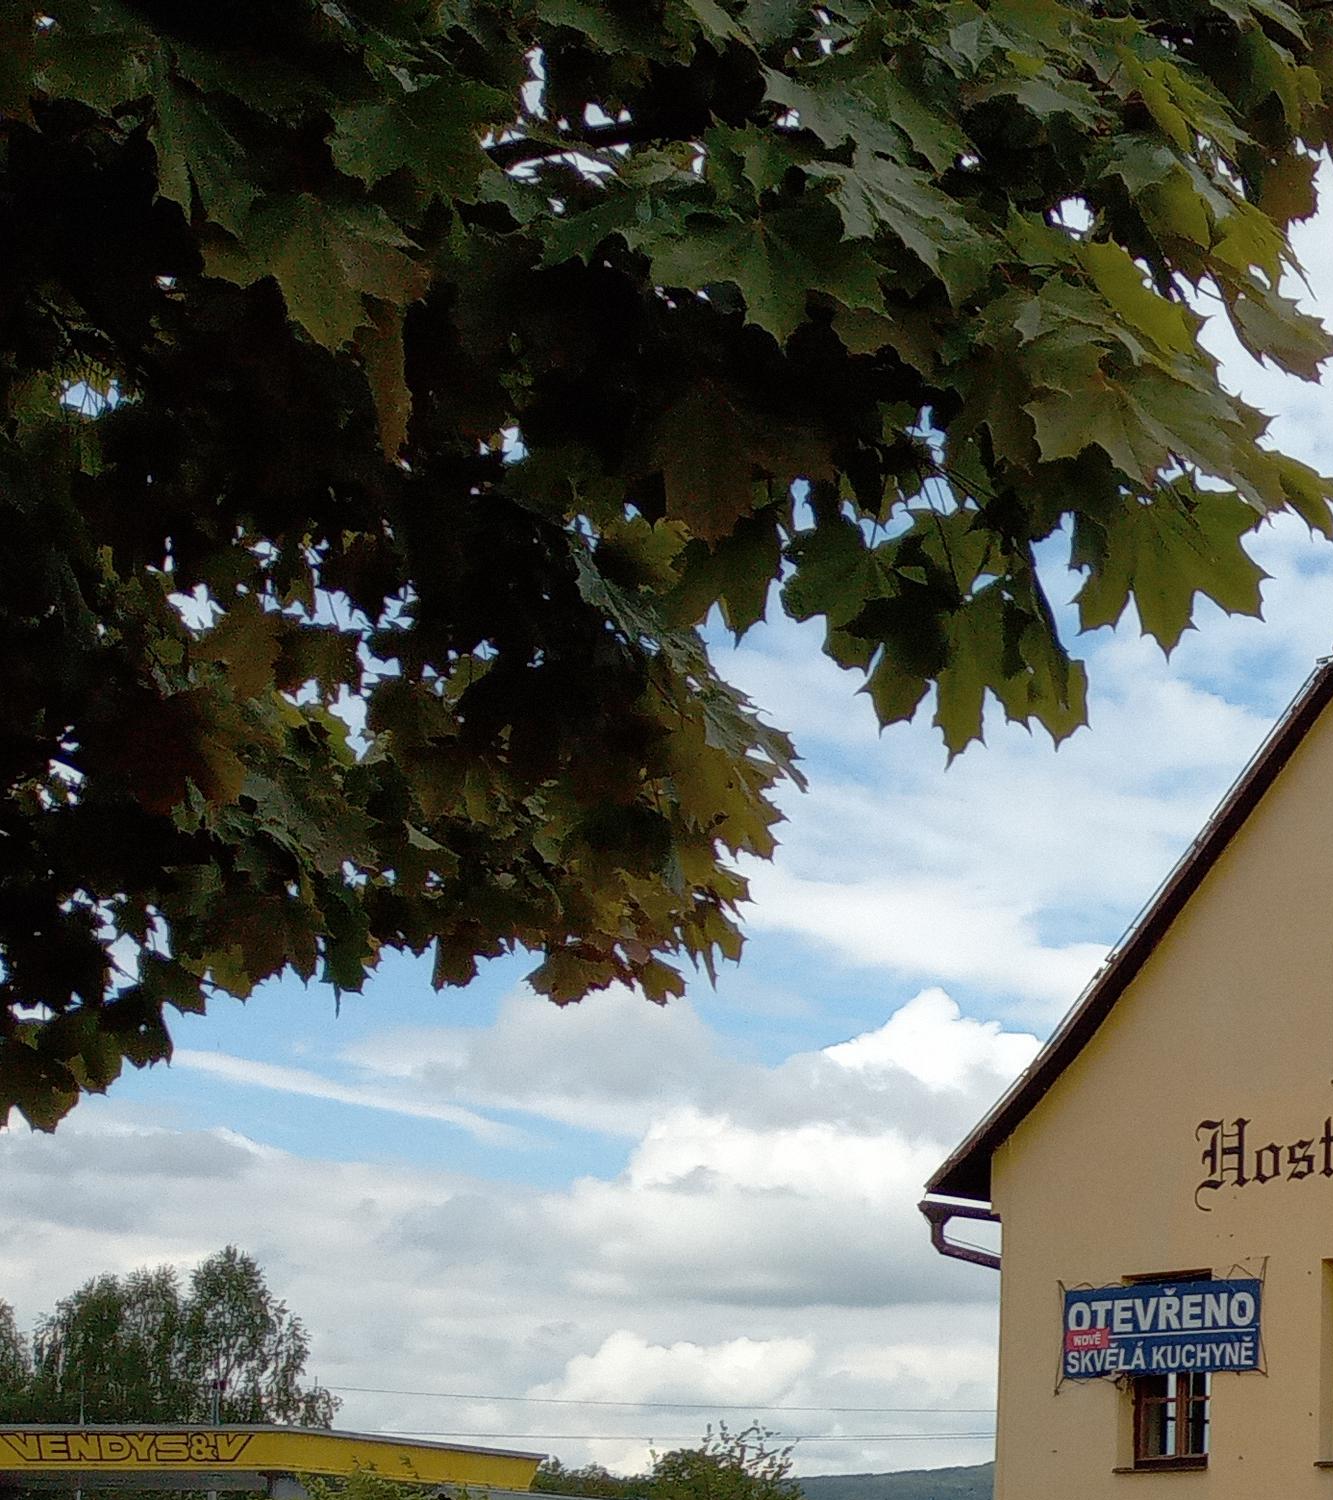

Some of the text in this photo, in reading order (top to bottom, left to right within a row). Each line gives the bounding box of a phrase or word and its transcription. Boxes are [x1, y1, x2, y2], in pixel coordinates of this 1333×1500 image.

[1067, 1287, 1256, 1333] OTEVŘENO
[1066, 1336, 1254, 1374] SKVĚLÁ KUCHYNĚ
